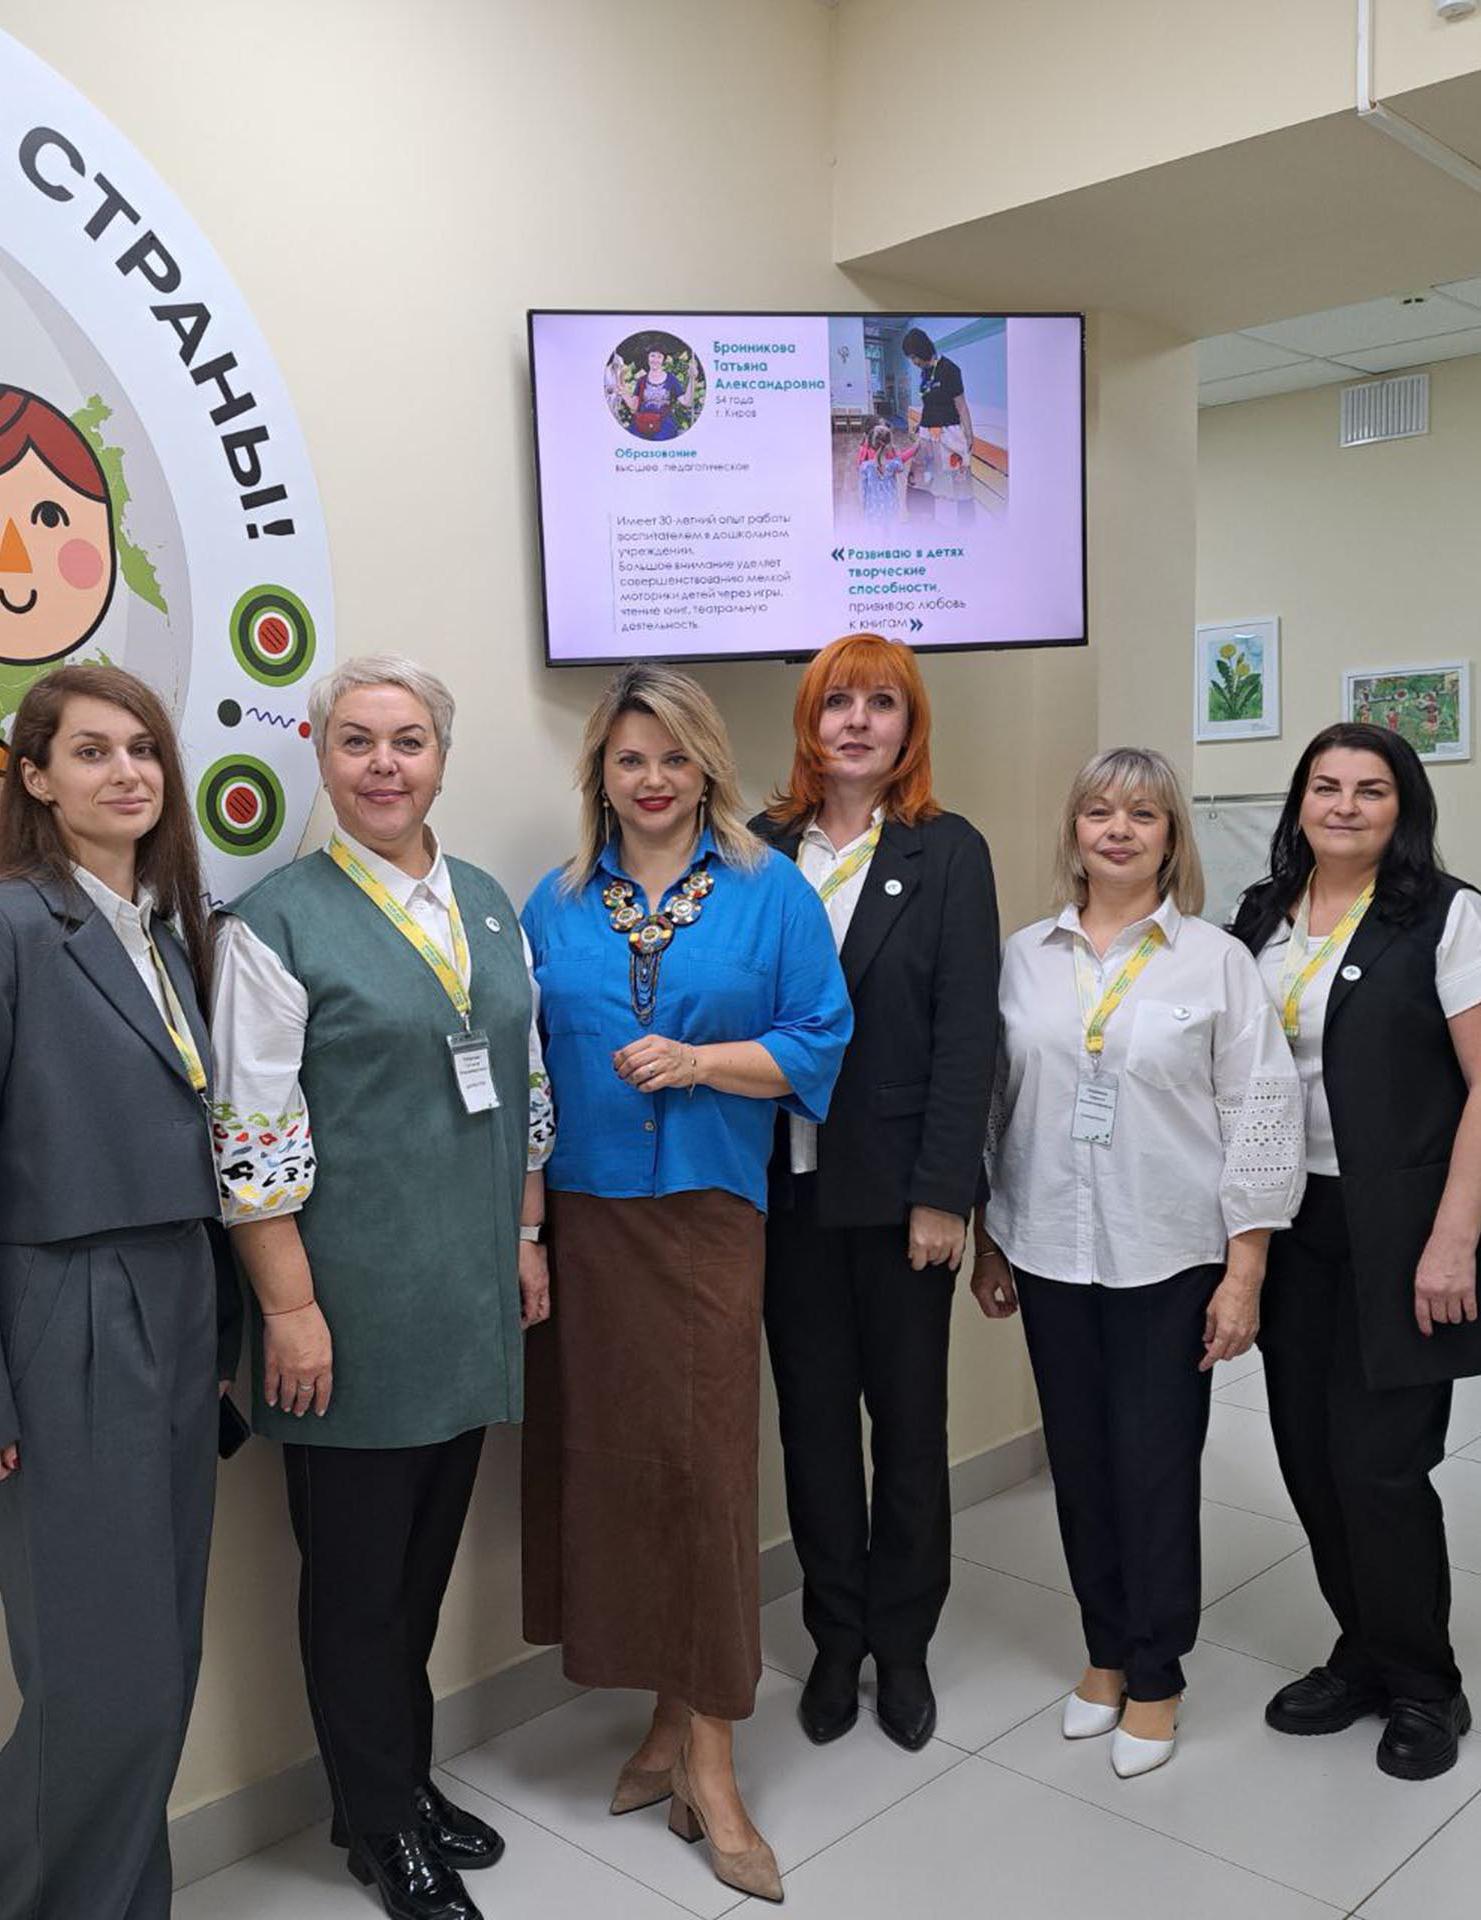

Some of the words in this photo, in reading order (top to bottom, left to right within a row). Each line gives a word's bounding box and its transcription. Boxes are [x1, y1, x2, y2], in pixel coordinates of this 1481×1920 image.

[18, 126, 295, 540] СТРАНЫ!
[713, 341, 796, 354] Бронникова
[714, 360, 768, 372] Татьяна
[715, 378, 826, 391] Александровна
[729, 396, 754, 406] года
[724, 408, 757, 420] Киров
[614, 448, 698, 460] Образование
[664, 462, 750, 472] педагогическое
[617, 515, 657, 526] Имеет
[720, 515, 745, 525] опыт
[747, 513, 791, 526] работы
[617, 531, 702, 542] воспитателем
[712, 530, 789, 540] дошкольном
[926, 548, 964, 558] детях
[619, 562, 673, 572] Большое
[675, 561, 734, 570] внимание
[736, 559, 781, 570] уделяет
[848, 566, 926, 579] творческие
[620, 575, 744, 588] совершенствованию
[746, 571, 791, 582] мелкой
[849, 582, 941, 595] способности,
[620, 592, 681, 603] моторики
[682, 589, 716, 600] детей
[718, 589, 751, 600] через
[621, 606, 661, 616] чтение
[693, 603, 768, 615] театральную
[849, 601, 914, 614] прививаю
[918, 597, 967, 609] любовь
[849, 621, 856, 629] к
